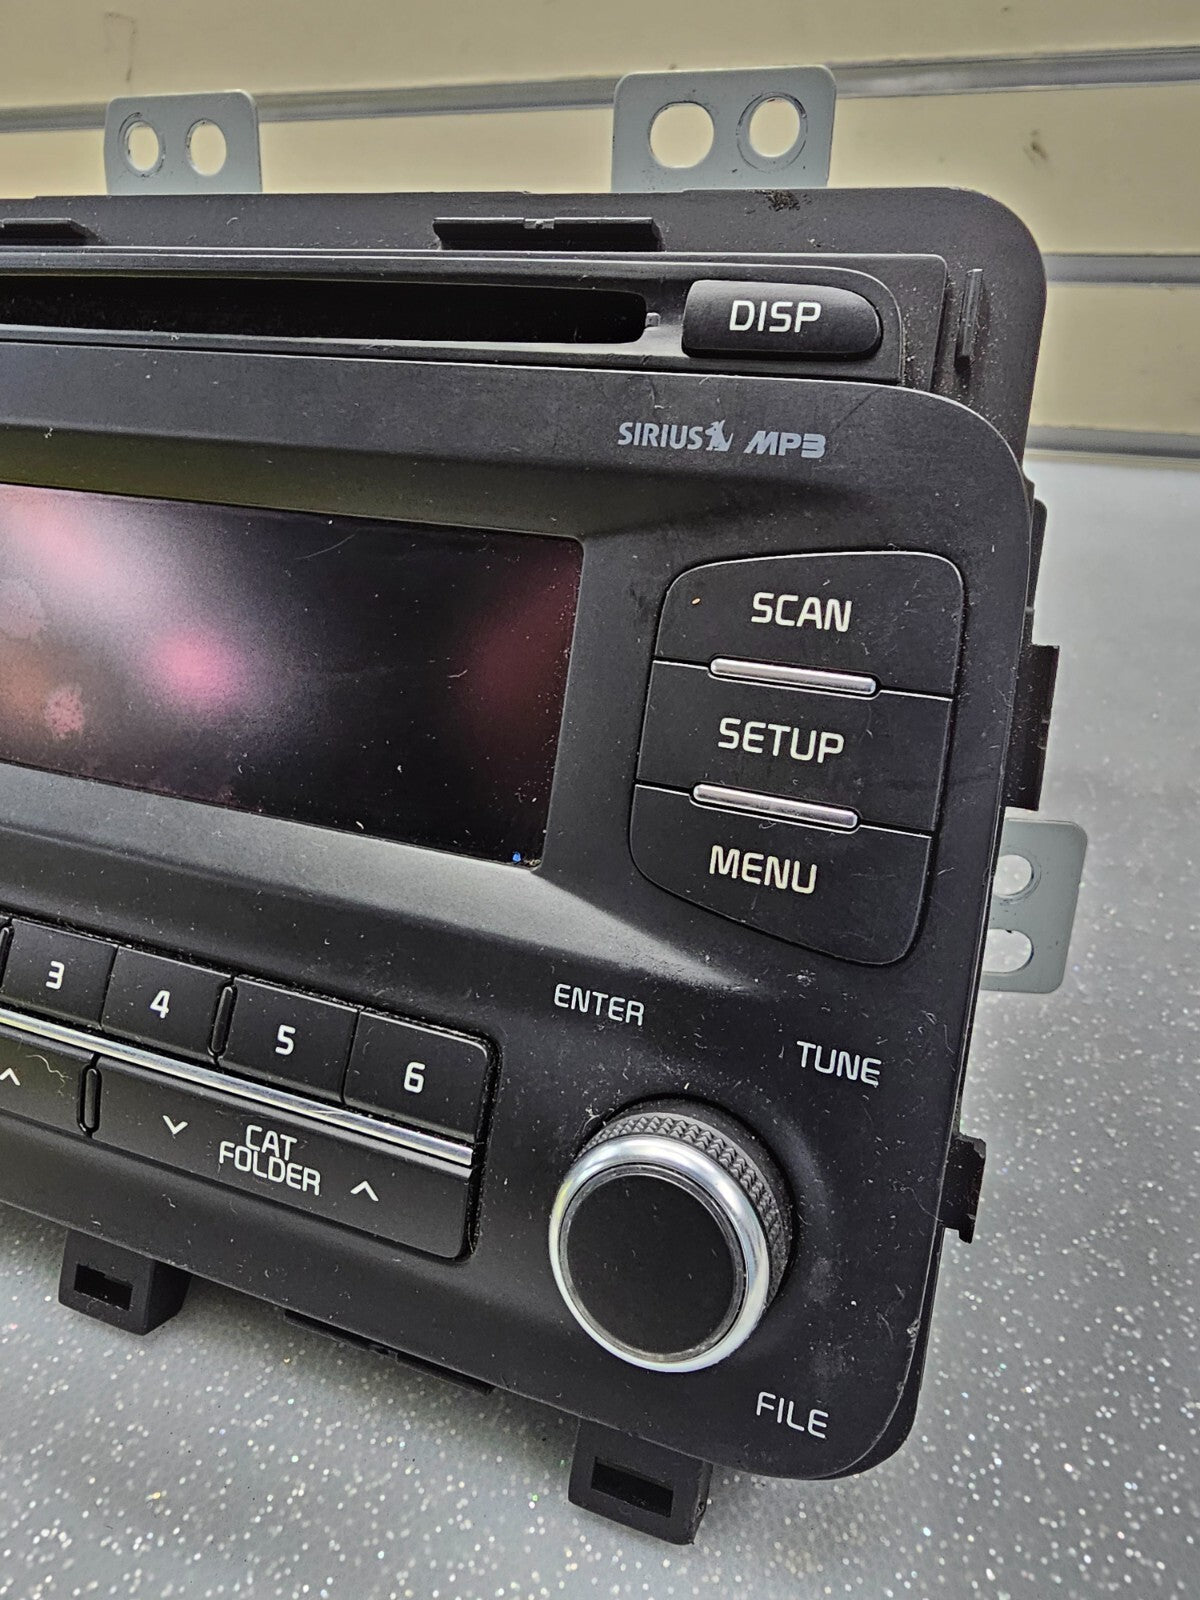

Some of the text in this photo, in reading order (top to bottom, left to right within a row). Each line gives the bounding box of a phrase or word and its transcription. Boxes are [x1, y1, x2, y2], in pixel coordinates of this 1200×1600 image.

[729, 299, 822, 334] DISP
[618, 421, 827, 459] SIRIUS MP3
[751, 592, 852, 633] SCAN
[718, 717, 845, 764] SETUP
[709, 845, 818, 894] MENU
[46, 961, 65, 990] 3
[150, 990, 170, 1019] 4
[553, 983, 645, 1027] ENTER
[275, 1025, 296, 1056] 5
[404, 1061, 426, 1094] 6
[796, 1040, 881, 1087] TUNE
[245, 1125, 298, 1160] CAT
[219, 1141, 321, 1196] FOLDER
[756, 1391, 829, 1439] FILE
